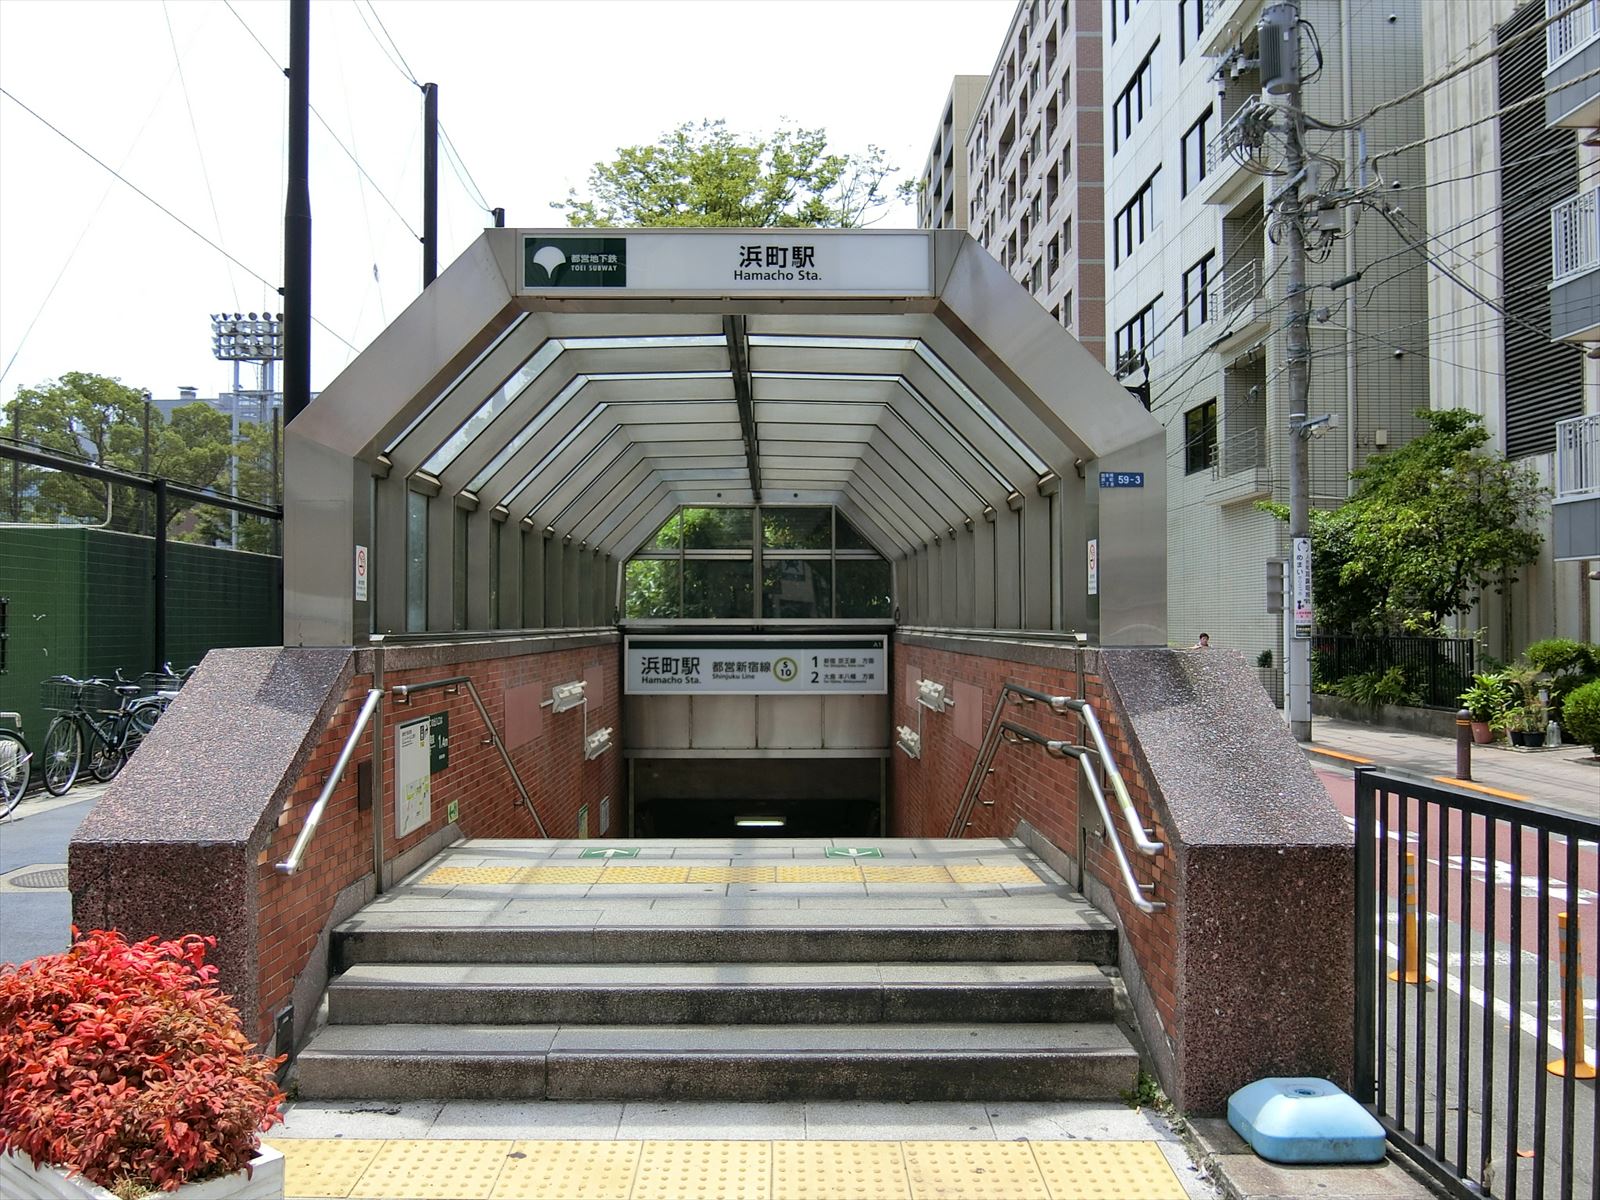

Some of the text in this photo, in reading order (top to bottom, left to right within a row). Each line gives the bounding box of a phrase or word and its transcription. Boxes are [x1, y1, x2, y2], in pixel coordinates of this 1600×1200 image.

[571, 254, 618, 263] 都営地下鉄
[739, 245, 815, 268] 浜町駅
[734, 270, 822, 281] Hamacho Sta.
[1118, 475, 1140, 484] 59-3
[641, 656, 700, 675] 浜町駅
[712, 661, 771, 672] 都営新宿線
[812, 656, 818, 668] 1
[781, 669, 792, 677] 10
[811, 671, 819, 683] 2
[641, 676, 702, 684] Hamacho Sta.
